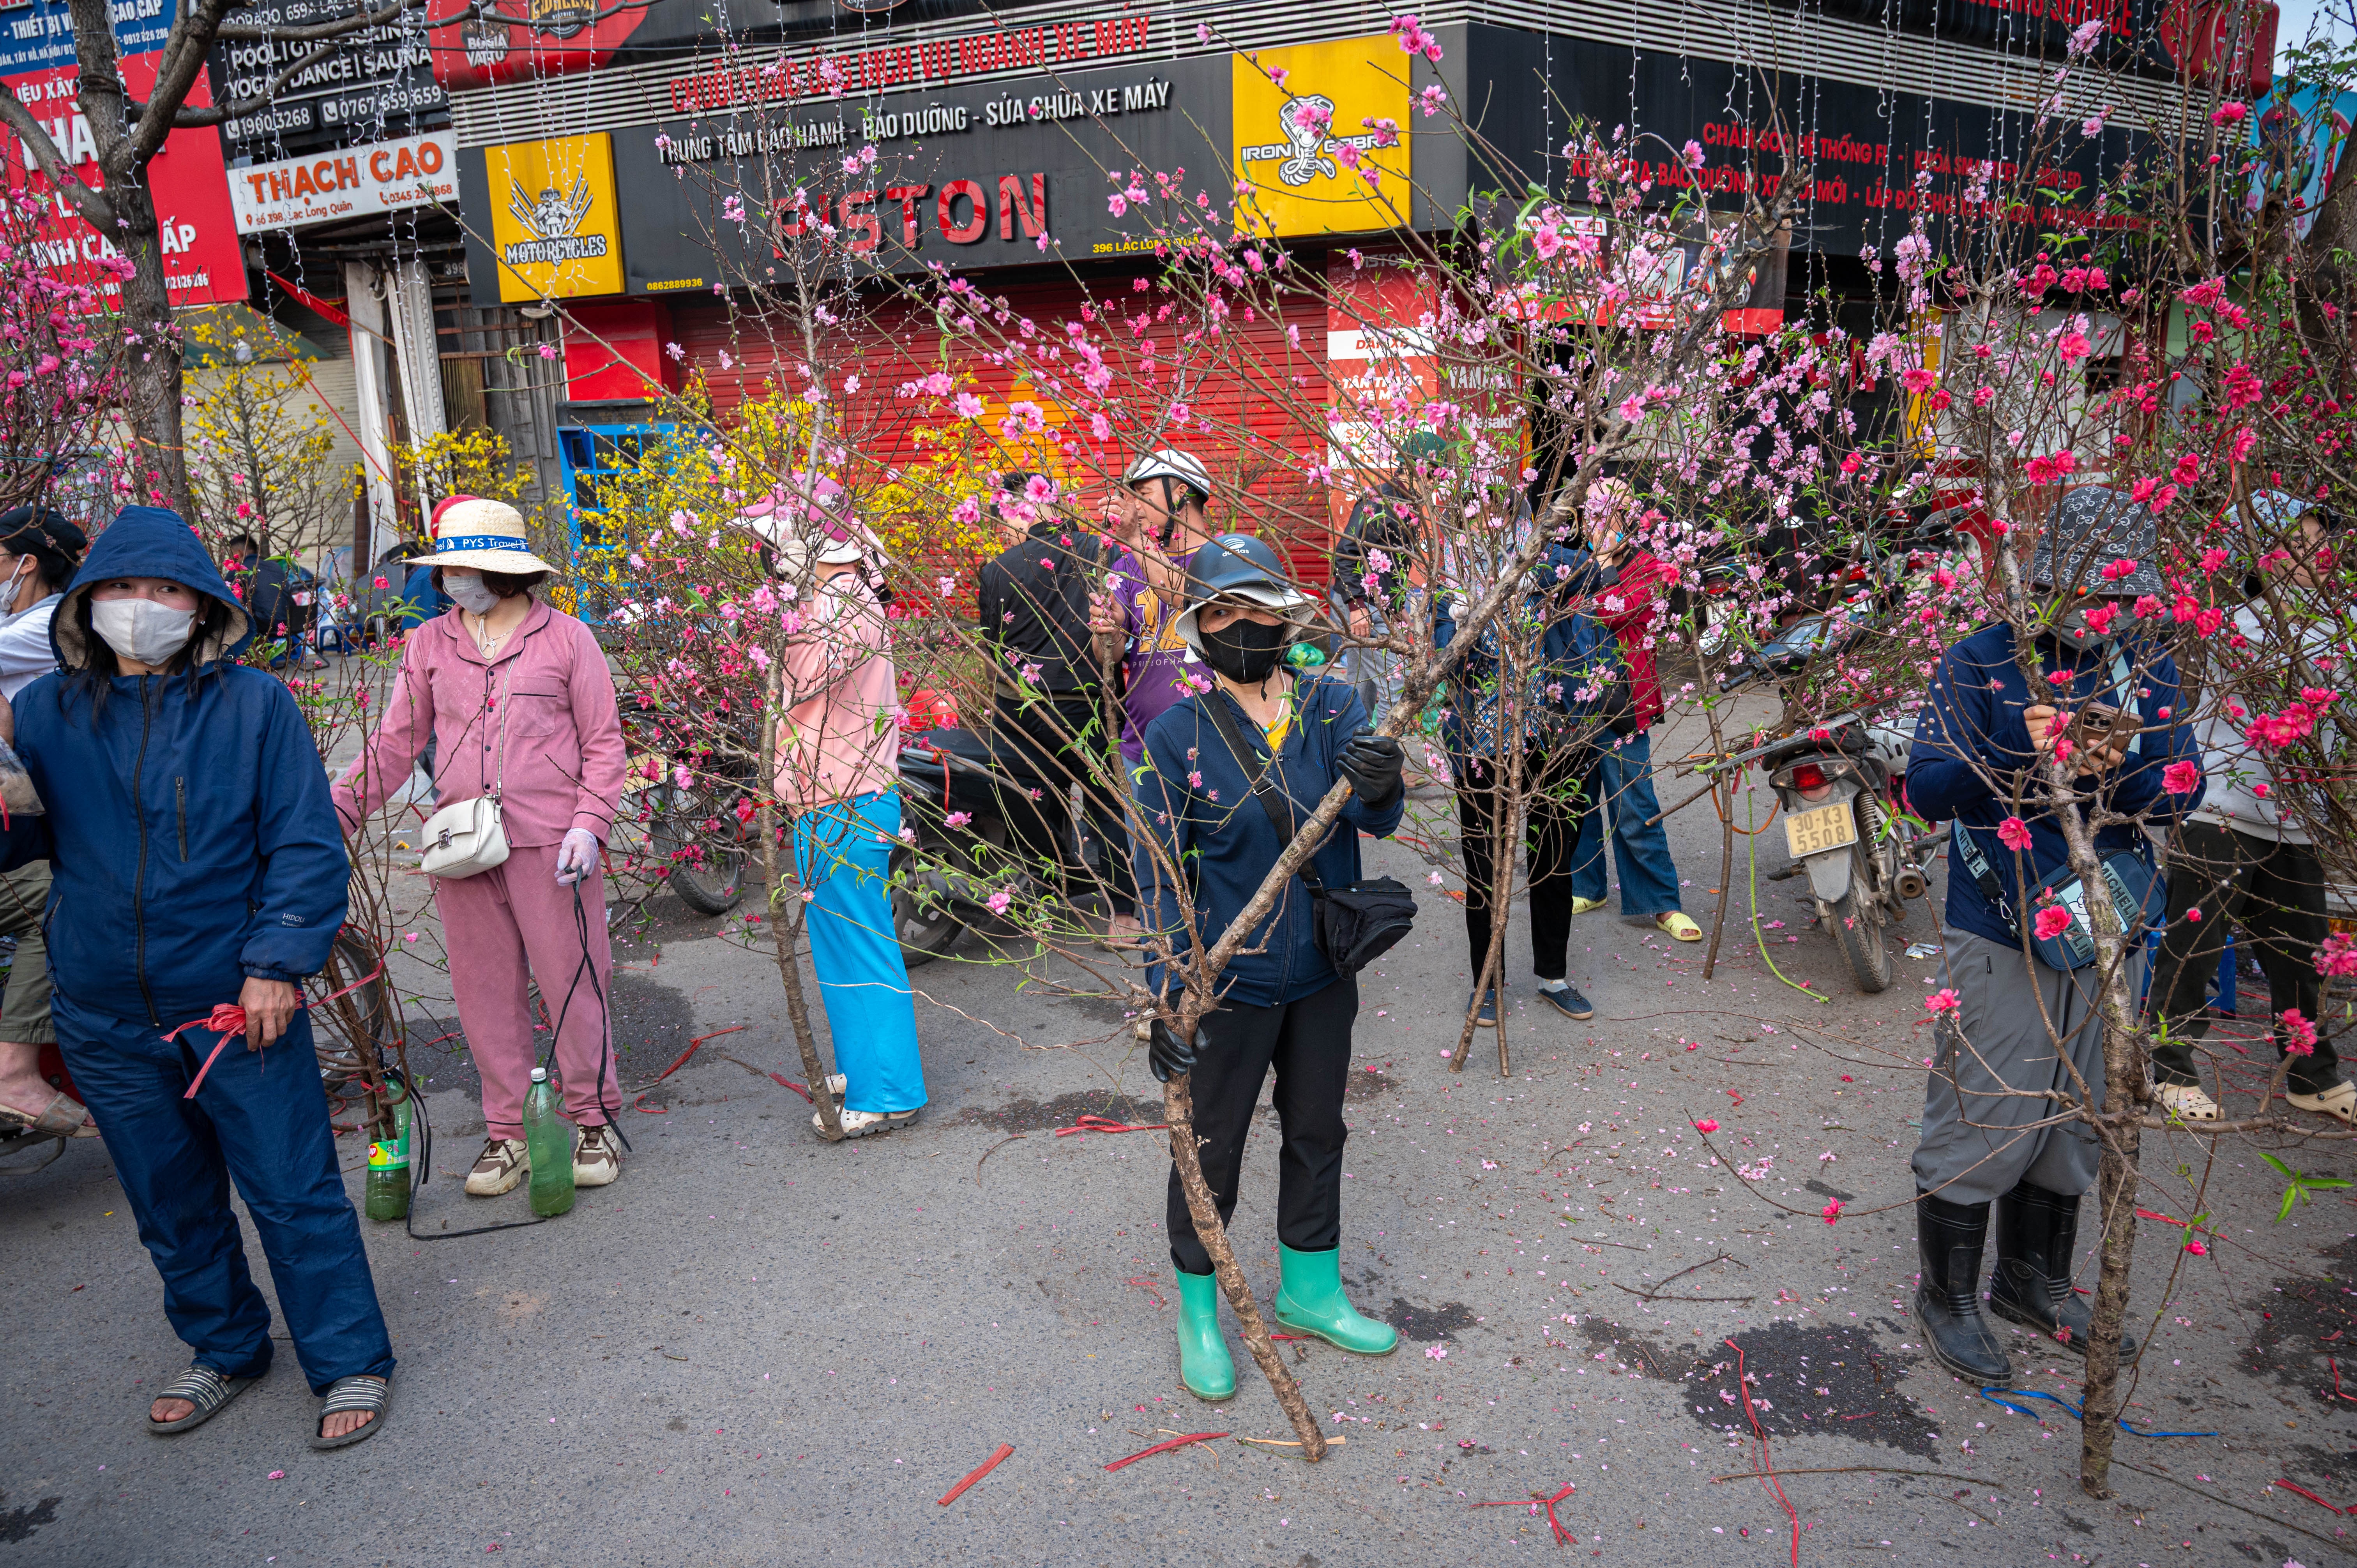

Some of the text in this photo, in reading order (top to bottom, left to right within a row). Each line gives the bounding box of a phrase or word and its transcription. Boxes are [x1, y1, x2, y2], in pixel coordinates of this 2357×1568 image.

[11, 12, 45, 40] THIẾT
[124, 33, 140, 45] 0912
[156, 27, 169, 40] 286
[231, 44, 281, 69] POOL
[917, 40, 952, 85] VỤ
[958, 19, 1046, 74] NGÀNH
[1053, 22, 1088, 61] XE
[1094, 2, 1152, 56] MÁY
[44, 76, 75, 101] XÂY
[276, 106, 311, 129] 3268
[339, 96, 376, 118] 0767
[383, 90, 408, 111] 659
[413, 85, 442, 106] 659
[903, 102, 967, 136] DƯỠNG
[986, 91, 1025, 126] SỬA
[1091, 88, 1119, 115] XE
[1125, 76, 1170, 111] MÁY
[1241, 143, 1293, 161] IRON
[1819, 133, 1873, 164] THỐNG
[247, 141, 443, 206] THẠCH CAO
[389, 191, 412, 204] 0345
[1816, 175, 1847, 204] MỚI
[306, 203, 328, 219] Long
[330, 201, 353, 217] Quân
[505, 234, 607, 267] MOTORCYCLES
[1092, 243, 1113, 253] 396
[1115, 240, 1139, 254] LẠC
[647, 277, 703, 291] 0862889936
[1356, 390, 1376, 401] XE
[463, 538, 484, 548] PYS
[488, 538, 519, 549] Travel
[1794, 806, 1843, 833] 30-K3
[1797, 825, 1846, 852] 5508
